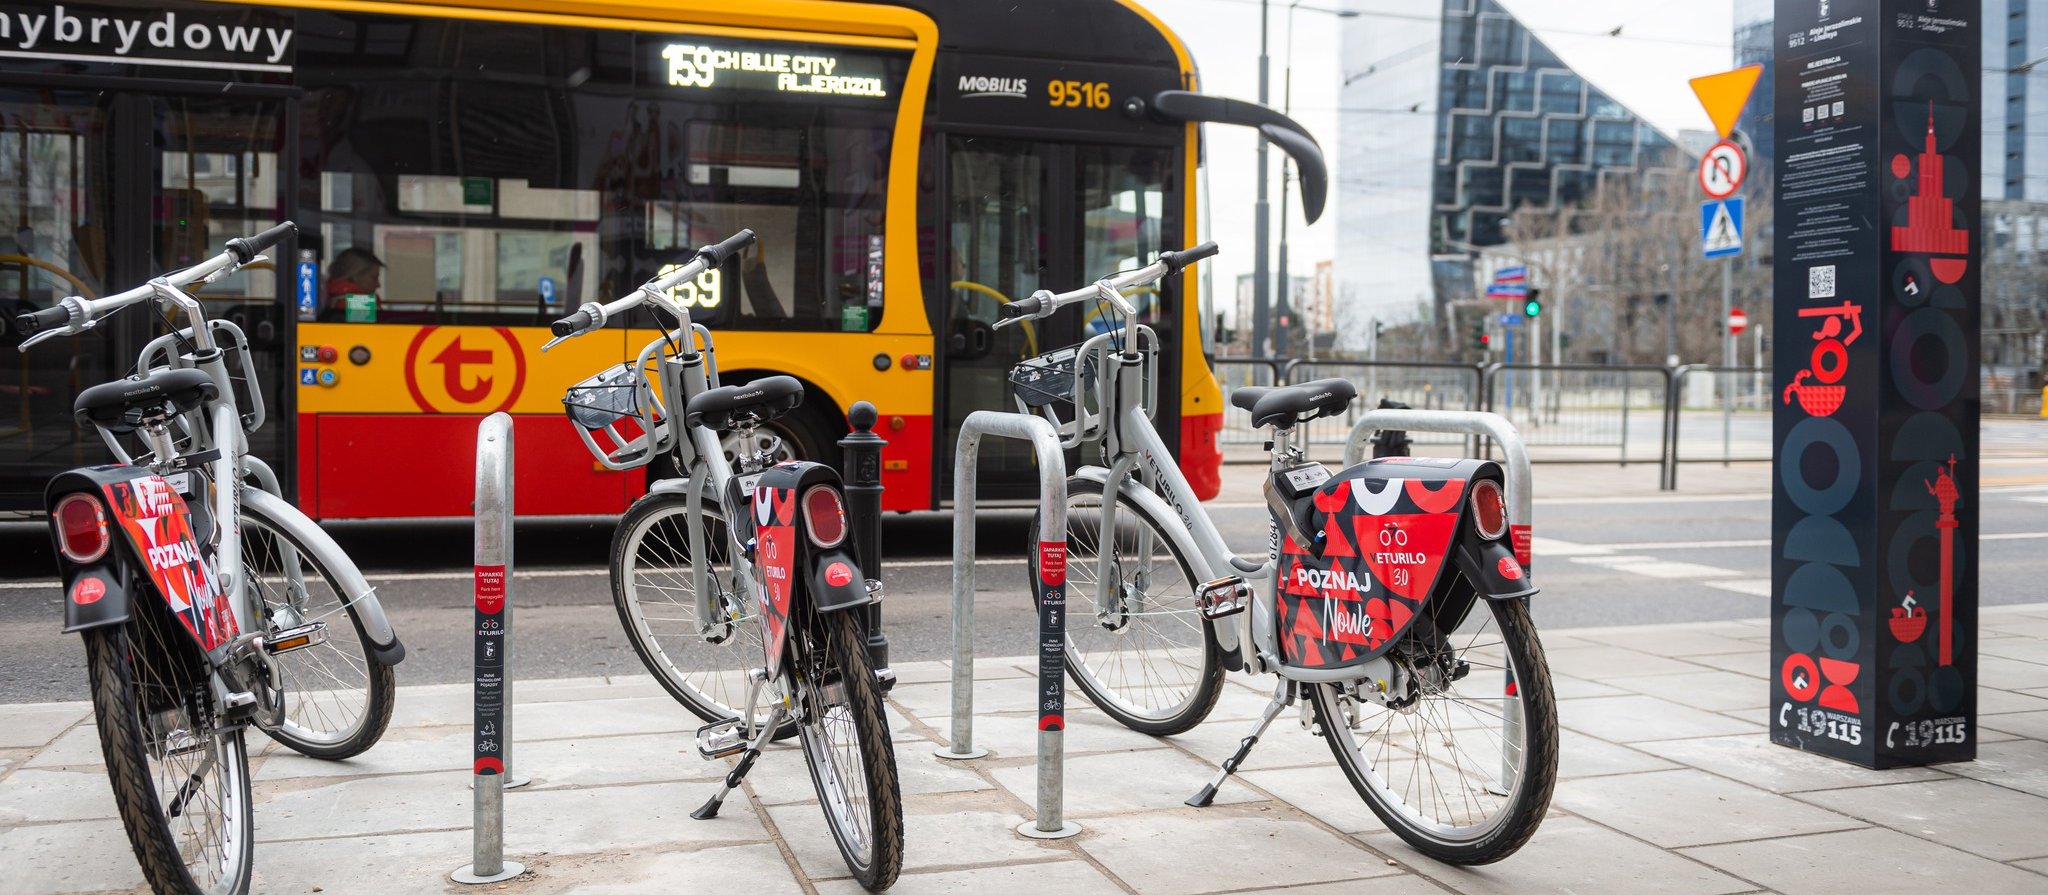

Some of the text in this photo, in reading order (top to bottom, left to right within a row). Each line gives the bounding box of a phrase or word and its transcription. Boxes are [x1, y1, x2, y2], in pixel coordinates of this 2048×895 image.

[662, 44, 714, 88] 159
[713, 50, 836, 76] CH BLUE CITY
[958, 75, 1027, 94] MOBILIS
[1048, 80, 1111, 109] 9516
[1144, 448, 1183, 515] VETURILO
[1369, 552, 1427, 565] VETURILO
[1296, 567, 1372, 593] POZNAJ
[1393, 567, 1409, 586] 3.0
[1322, 591, 1374, 647] Nowe
[1826, 711, 1861, 726] WARSZAWA
